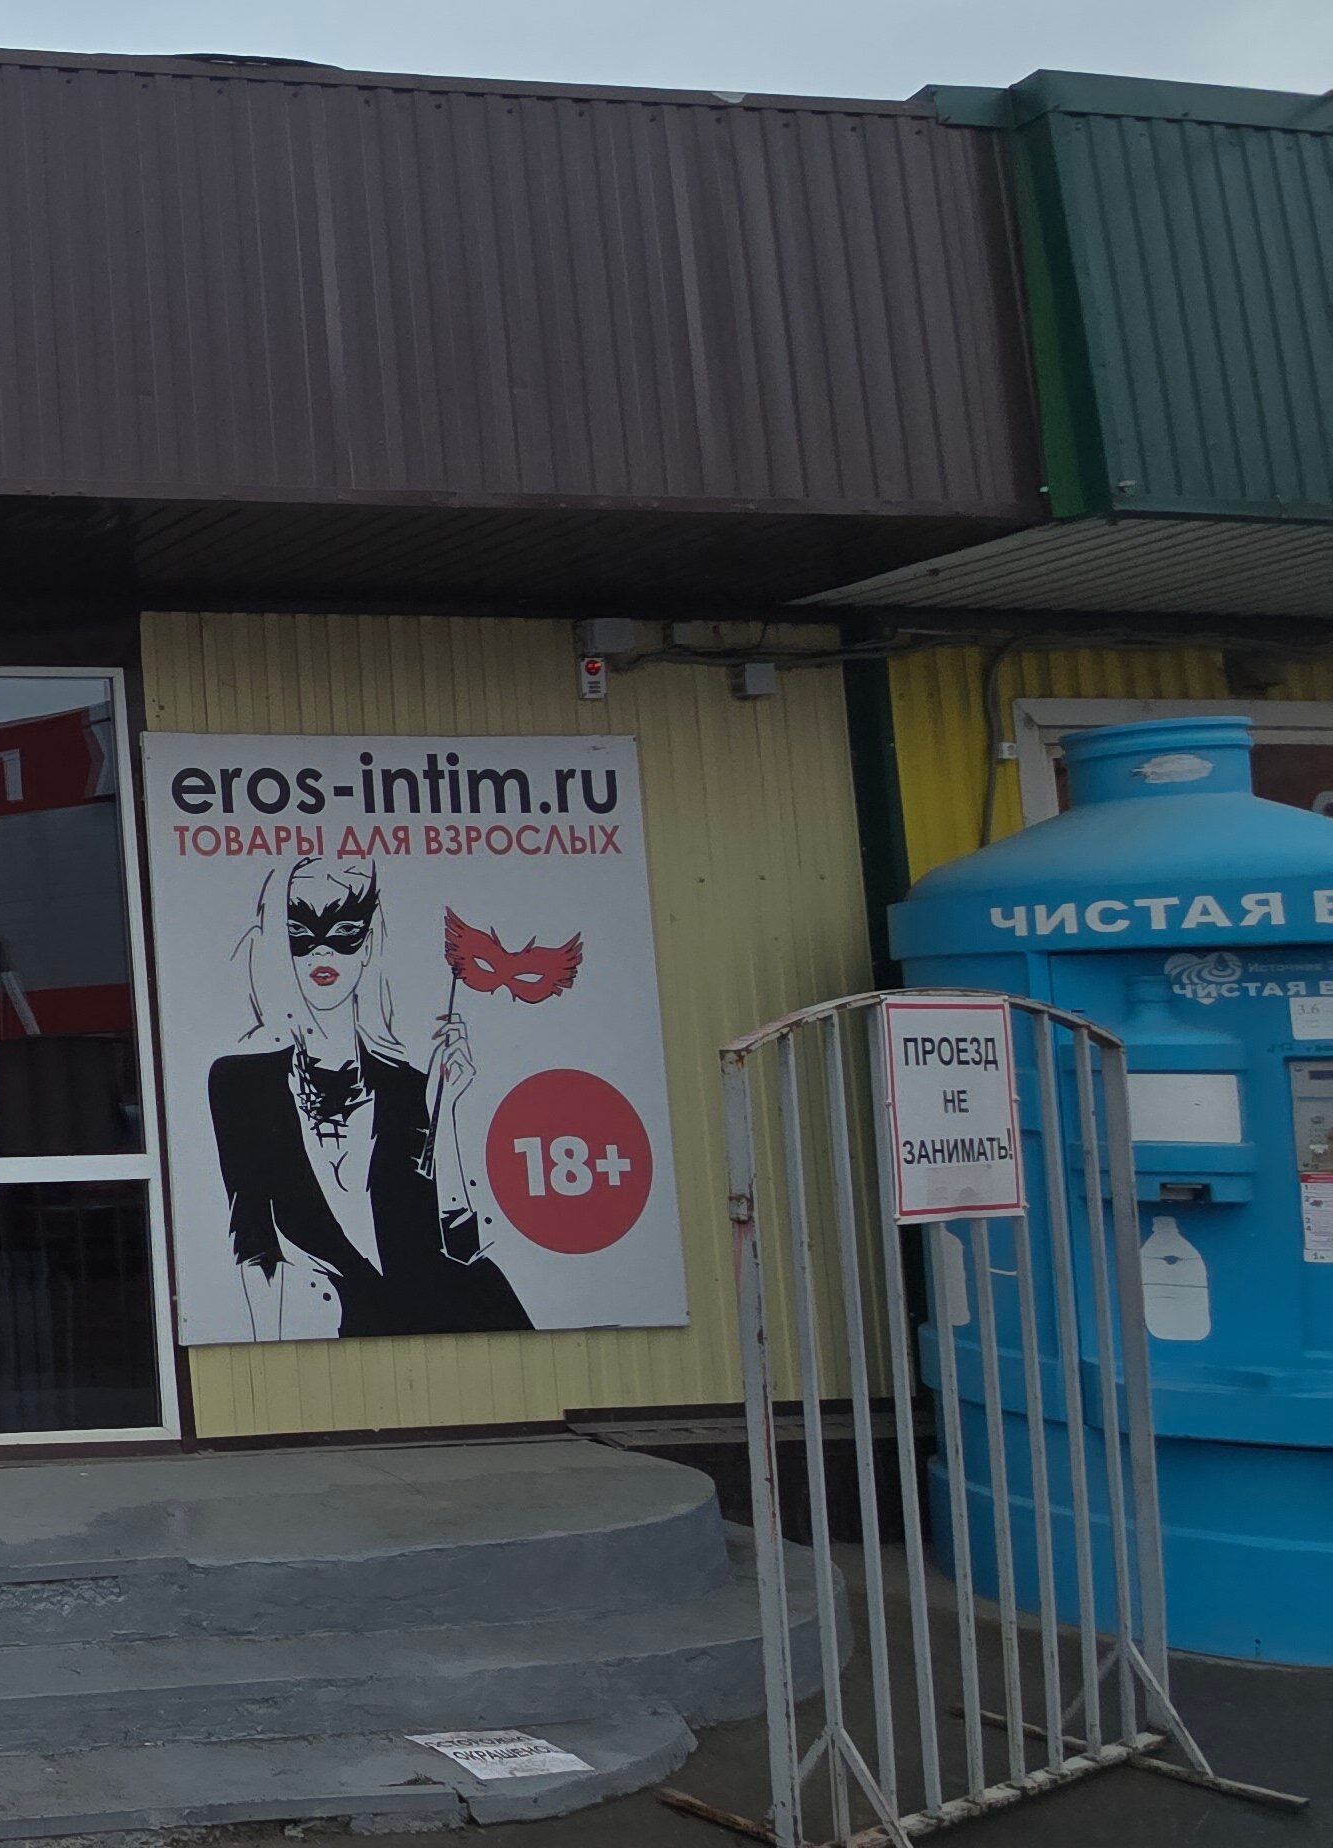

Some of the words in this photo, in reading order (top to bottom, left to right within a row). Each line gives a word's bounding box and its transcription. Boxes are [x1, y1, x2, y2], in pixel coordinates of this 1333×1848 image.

[171, 751, 618, 815] eros-intim.ru
[172, 824, 324, 857] ТОВАРЫ
[336, 824, 411, 860] ДЛЯ
[425, 824, 622, 856] ВЗРОСЛЫХ
[990, 892, 1285, 937] ЧИСТАЯ
[1172, 980, 1307, 998] ЧИСТАЯ
[903, 1037, 999, 1071] ПРОЕЗД
[943, 1090, 969, 1113] НЕ
[902, 1128, 1013, 1164] ЗАНИМАТЬ!
[513, 1135, 631, 1197] 18+
